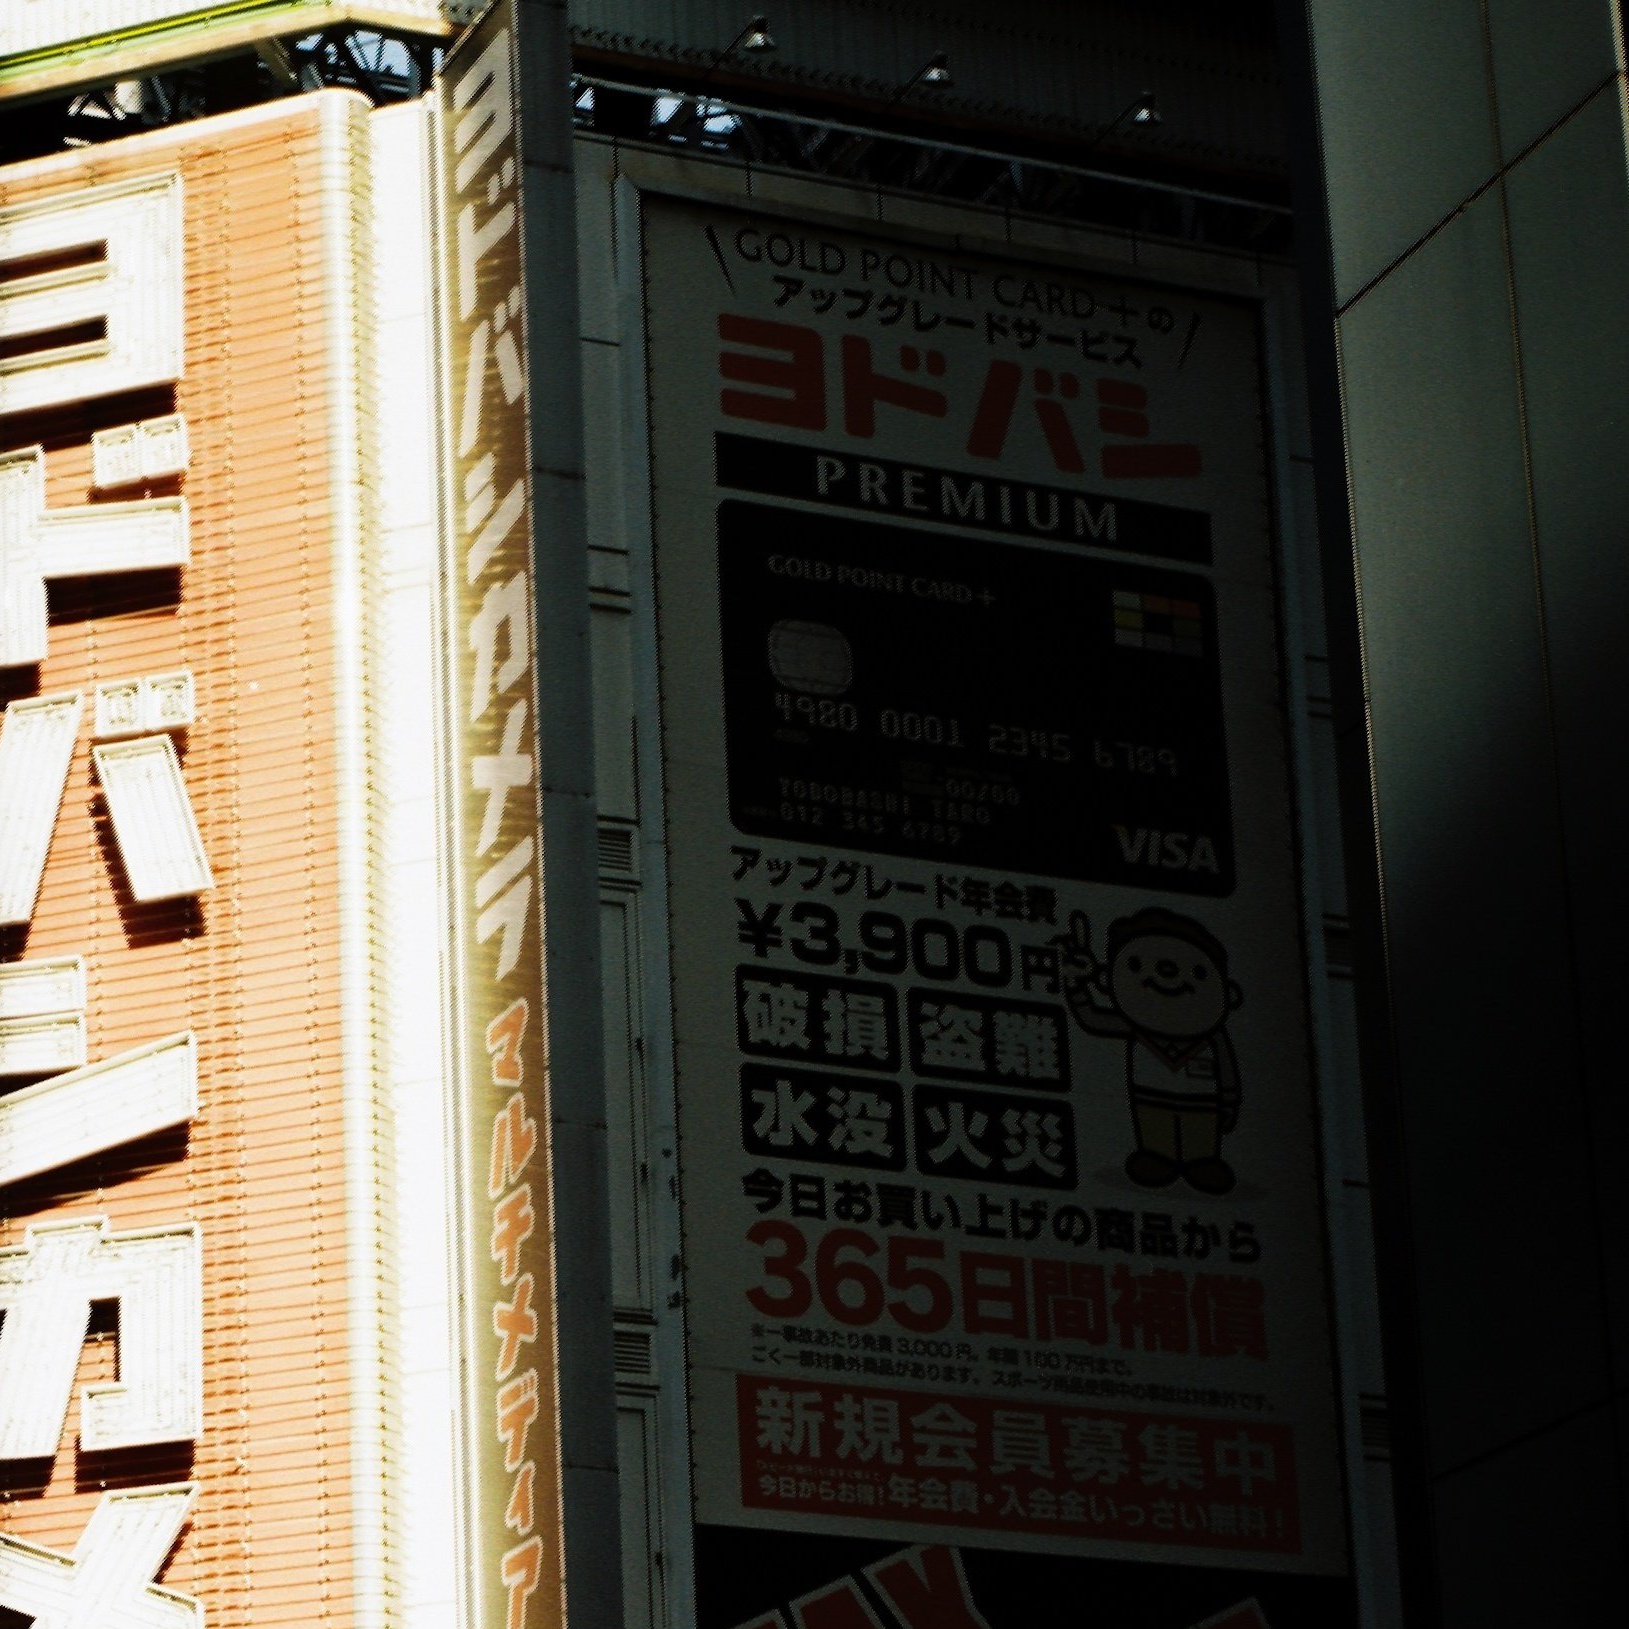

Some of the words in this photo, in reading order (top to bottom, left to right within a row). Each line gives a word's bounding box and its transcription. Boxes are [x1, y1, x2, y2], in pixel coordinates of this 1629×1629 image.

[733, 229, 846, 274] GOLD
[863, 250, 974, 299] POINT
[994, 274, 1095, 320] CARD
[773, 278, 1143, 368] アップグレードサービス
[719, 314, 1202, 479] ヨドバシ
[452, 28, 535, 980] ヨドバシカメラ
[815, 456, 1122, 542] PREMIUM
[767, 554, 830, 581] GOLD
[839, 563, 904, 591] POINT
[912, 575, 968, 604] CARD
[880, 708, 965, 749] 0001
[986, 722, 1072, 765] 2345
[729, 847, 1058, 925] アップグレード年会費
[1113, 824, 1222, 876] VISA
[734, 897, 1065, 996] ¥3,900円
[744, 973, 897, 1064] 破損
[912, 992, 1064, 1082] 盗難
[752, 1076, 898, 1161] 水没
[927, 1097, 1066, 1182] 火災
[742, 1169, 1263, 1264] 今日お買い上げの商品から
[745, 1219, 1268, 1362] 365日間補償
[755, 1385, 1277, 1498] 新規会員募集中
